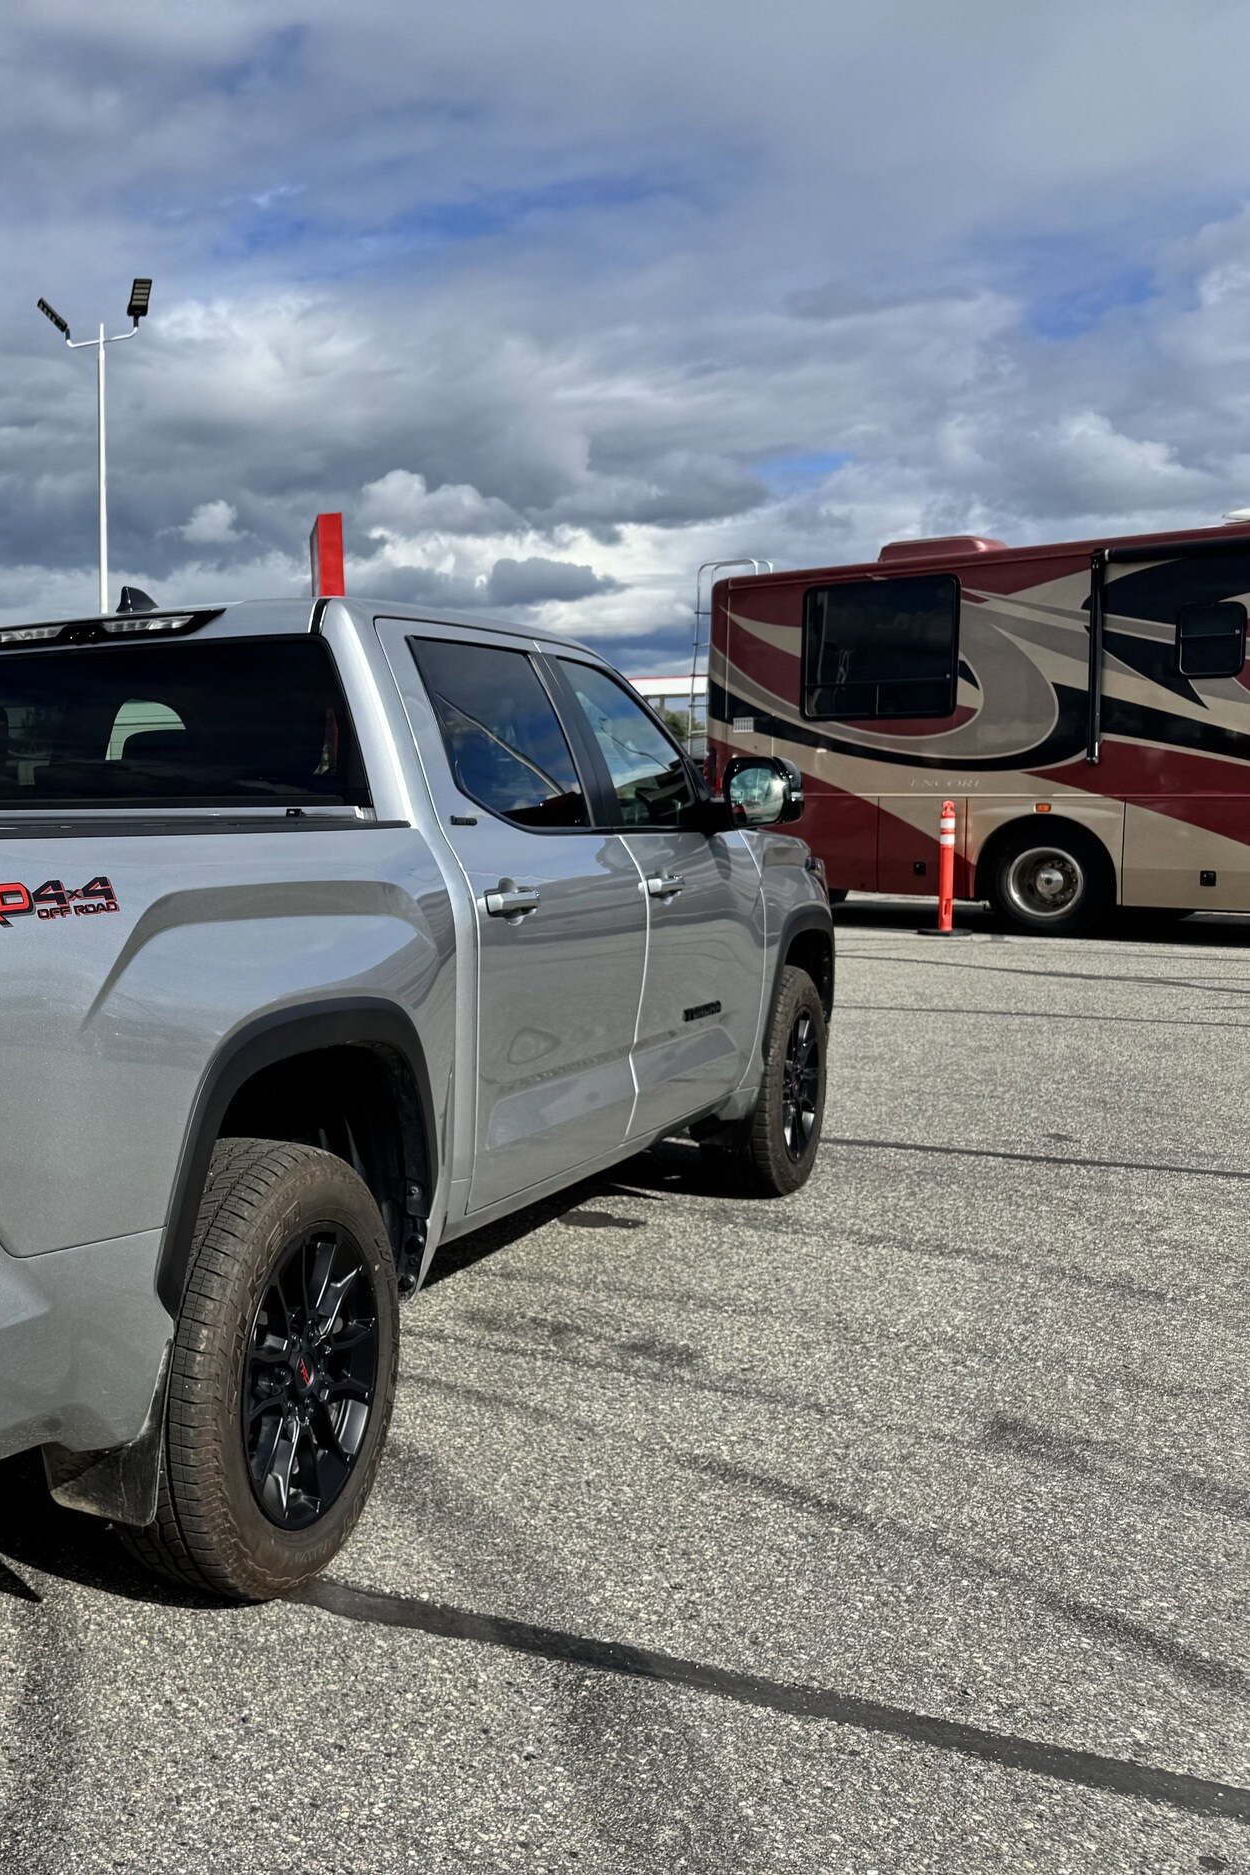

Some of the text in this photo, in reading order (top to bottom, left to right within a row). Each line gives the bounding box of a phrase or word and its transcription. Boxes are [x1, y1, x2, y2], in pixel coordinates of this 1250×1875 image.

[32, 876, 118, 907] 4x4
[37, 901, 121, 921] OFF ROAD
